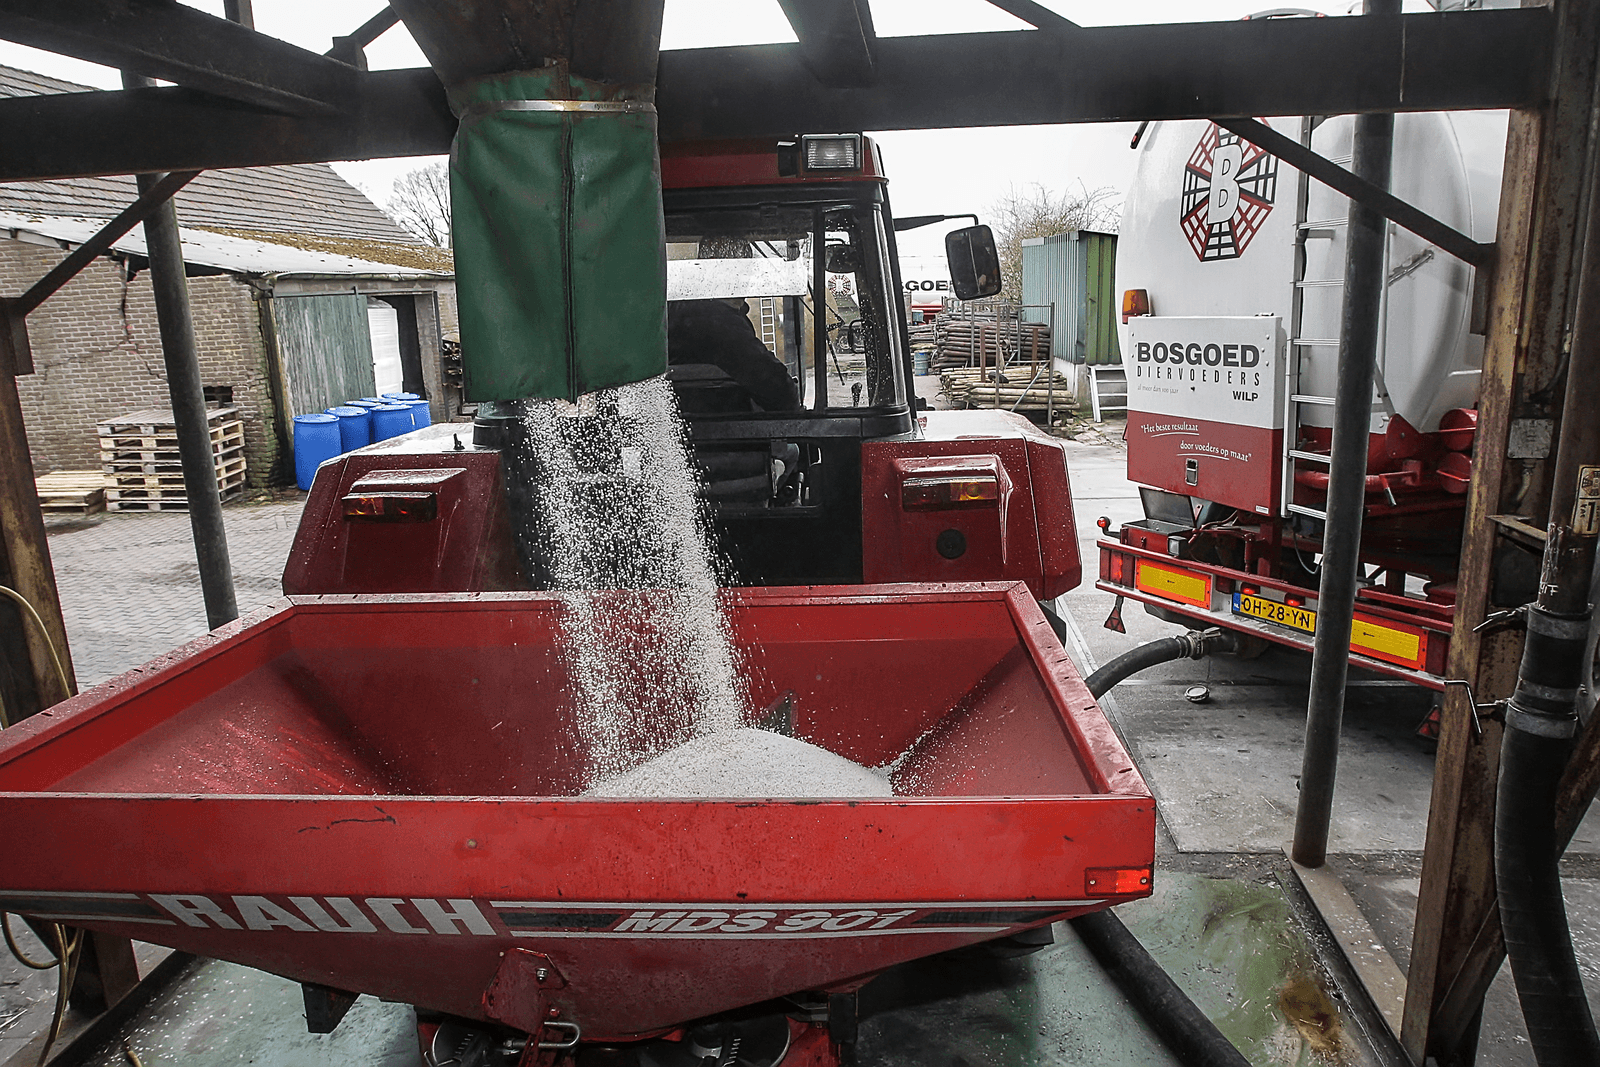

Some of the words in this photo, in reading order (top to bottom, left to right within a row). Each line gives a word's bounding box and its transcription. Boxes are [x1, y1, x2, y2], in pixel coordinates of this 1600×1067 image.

[1207, 144, 1243, 225] B
[901, 280, 955, 291] GOE
[1137, 342, 1260, 367] BOSGOED
[1137, 365, 1260, 386] DIERVOEDERS
[1232, 390, 1259, 401] WILP
[1155, 422, 1171, 431] beste
[1171, 421, 1199, 431] resultaat
[1180, 440, 1194, 450] door
[1195, 442, 1220, 454] voeders
[1220, 448, 1229, 457] op
[1243, 598, 1310, 628] OH-28-YN
[147, 894, 497, 935] RAUCH
[613, 911, 777, 932] MDS
[775, 910, 917, 932] 901
